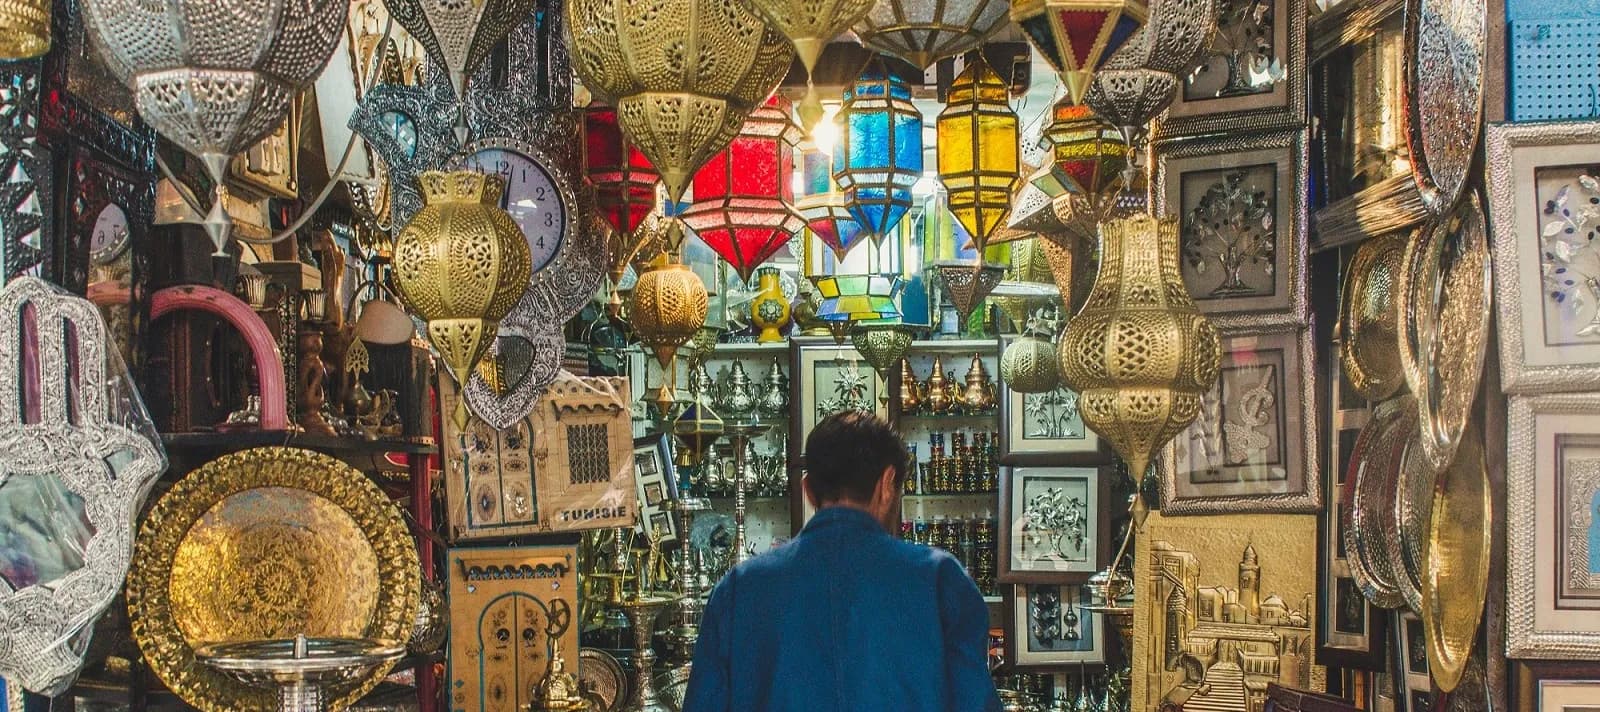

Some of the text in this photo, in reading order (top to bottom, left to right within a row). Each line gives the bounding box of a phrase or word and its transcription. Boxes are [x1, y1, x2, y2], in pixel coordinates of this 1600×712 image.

[496, 161, 509, 175] 12
[522, 169, 526, 183] 1
[535, 186, 545, 202] 2
[544, 212, 553, 228] 3
[536, 235, 545, 249] 4
[561, 506, 626, 522] TUNISIE
